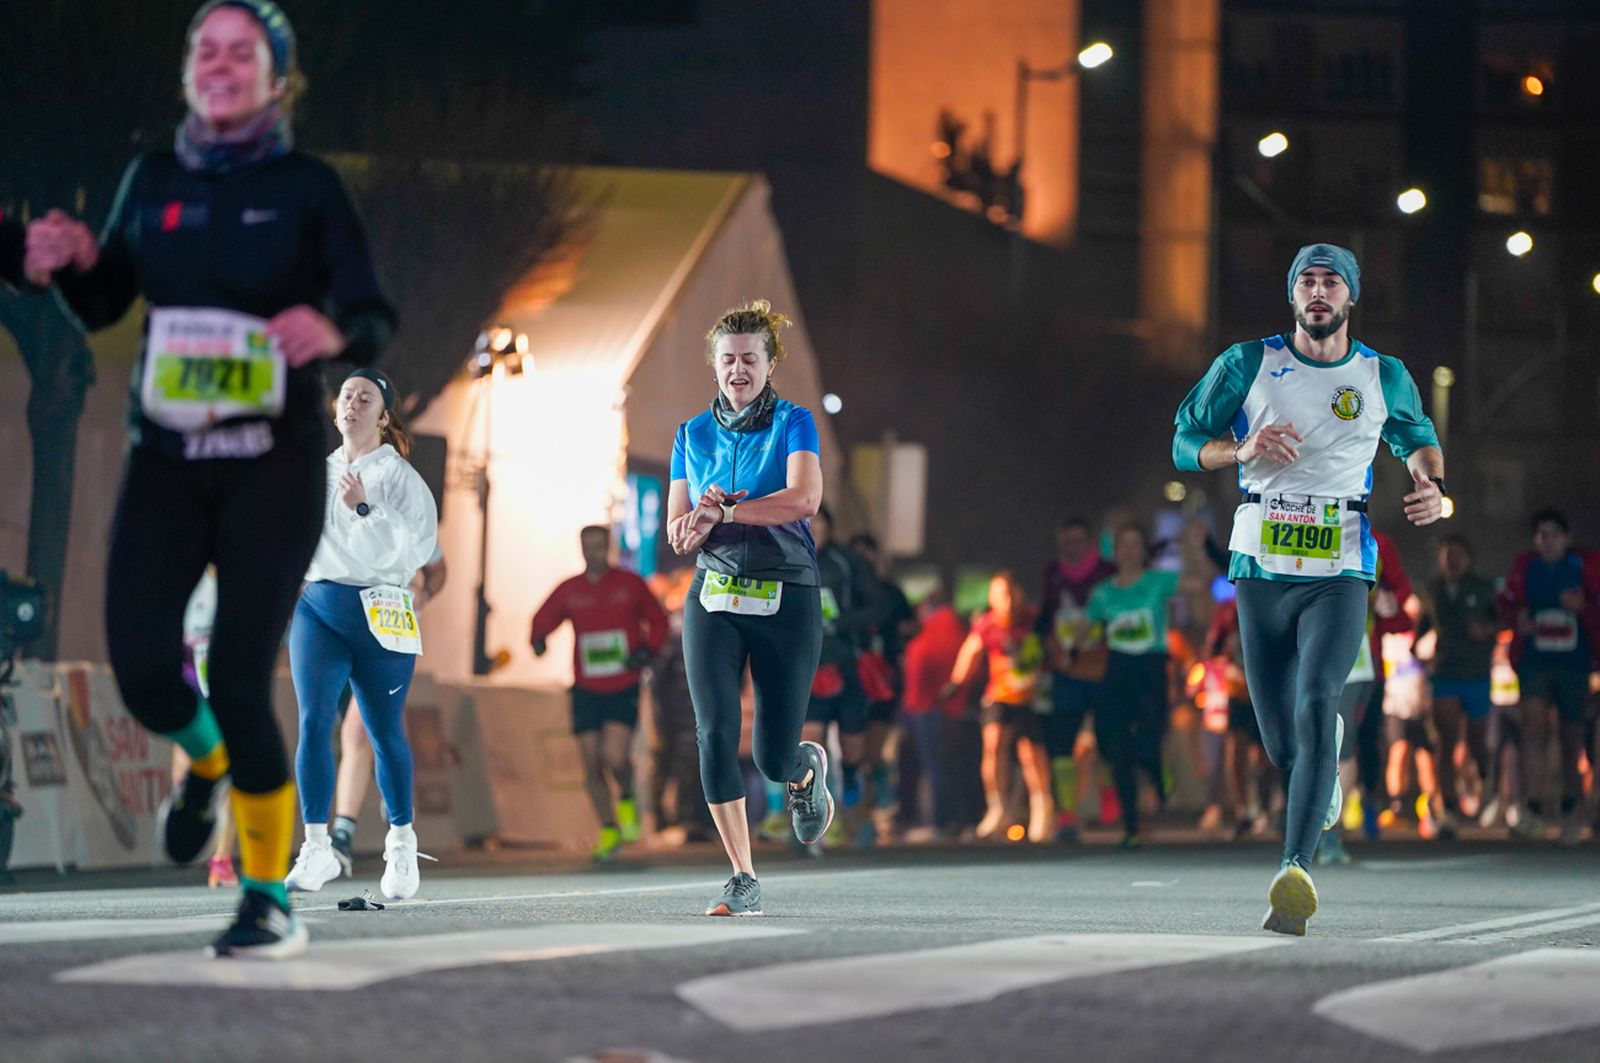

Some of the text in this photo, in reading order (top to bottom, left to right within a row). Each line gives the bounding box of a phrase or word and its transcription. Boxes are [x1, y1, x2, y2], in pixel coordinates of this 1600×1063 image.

[1268, 512, 1286, 521] SAN
[1270, 522, 1333, 550] 12190
[376, 608, 414, 630] 12213
